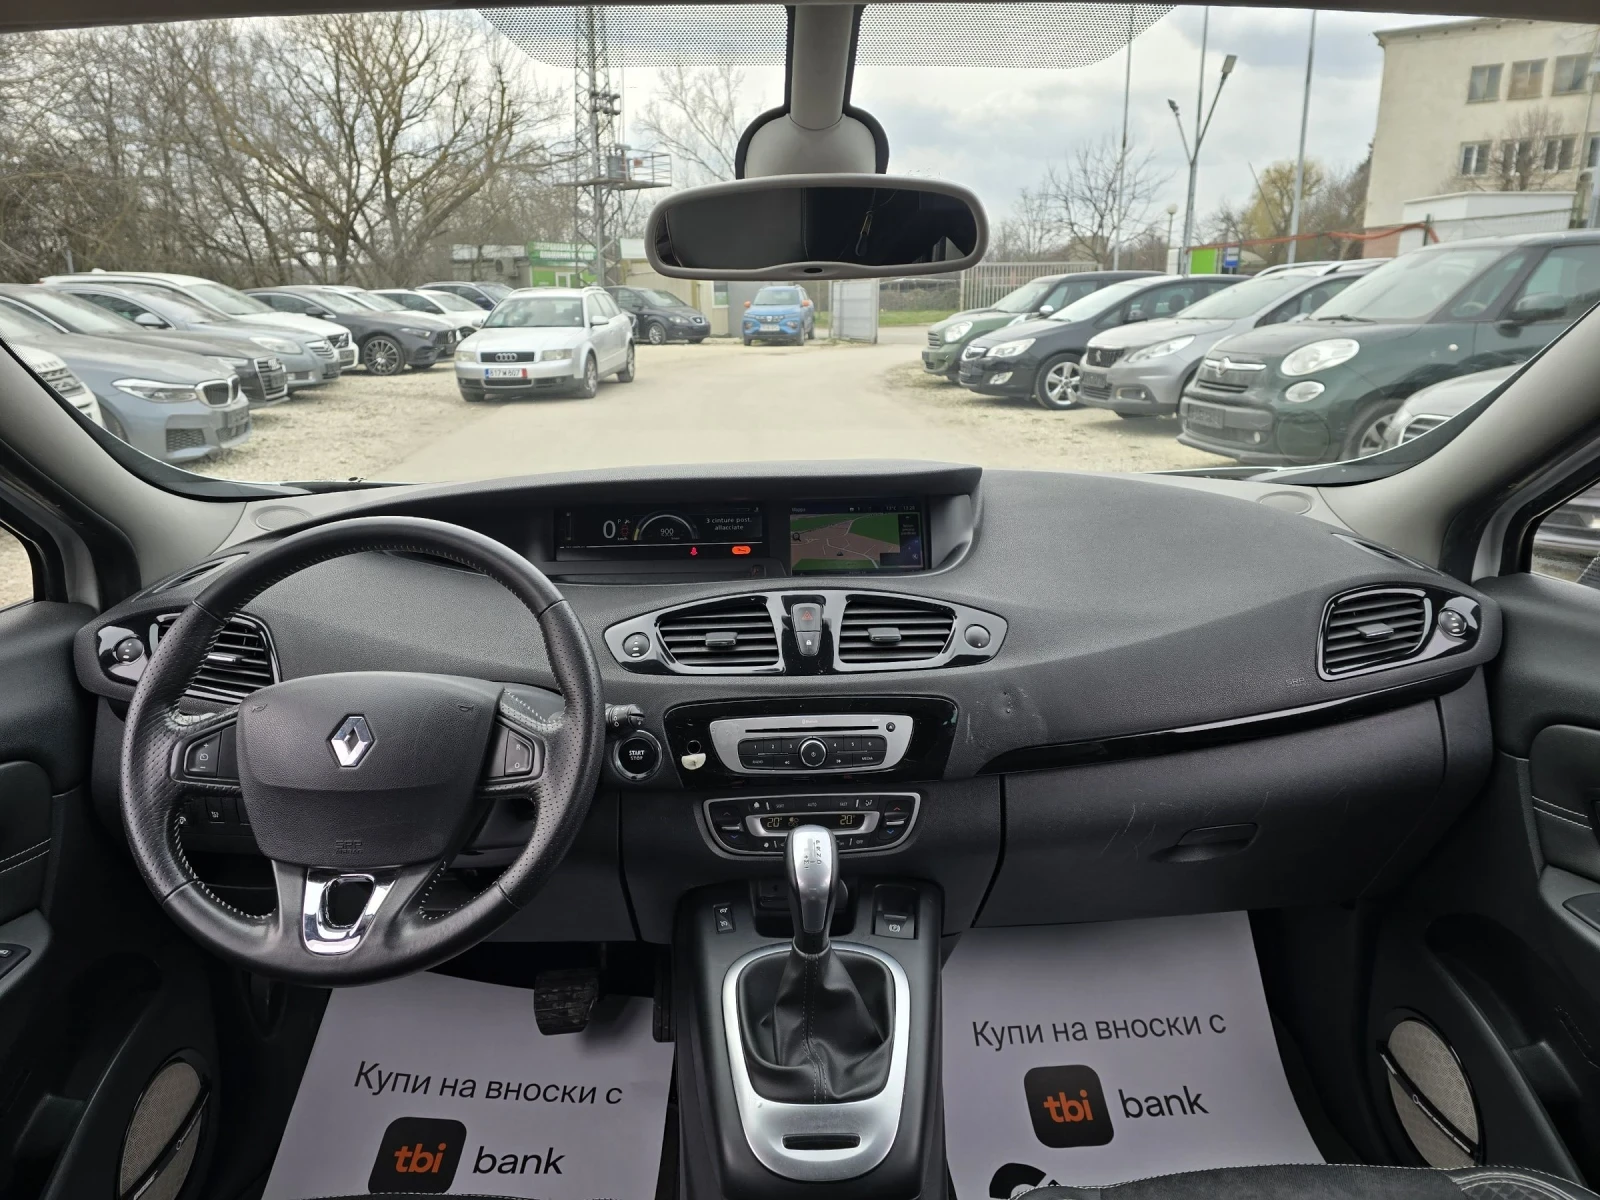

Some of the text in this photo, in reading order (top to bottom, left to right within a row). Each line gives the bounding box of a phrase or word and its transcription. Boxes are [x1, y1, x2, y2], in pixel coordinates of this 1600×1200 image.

[602, 519, 616, 539] 0
[972, 1014, 1227, 1052] Купи на вноски с
[354, 1060, 623, 1104] Купи на вноски с
[1043, 1085, 1209, 1123] tbi bank
[393, 1143, 566, 1175] tbi bank
